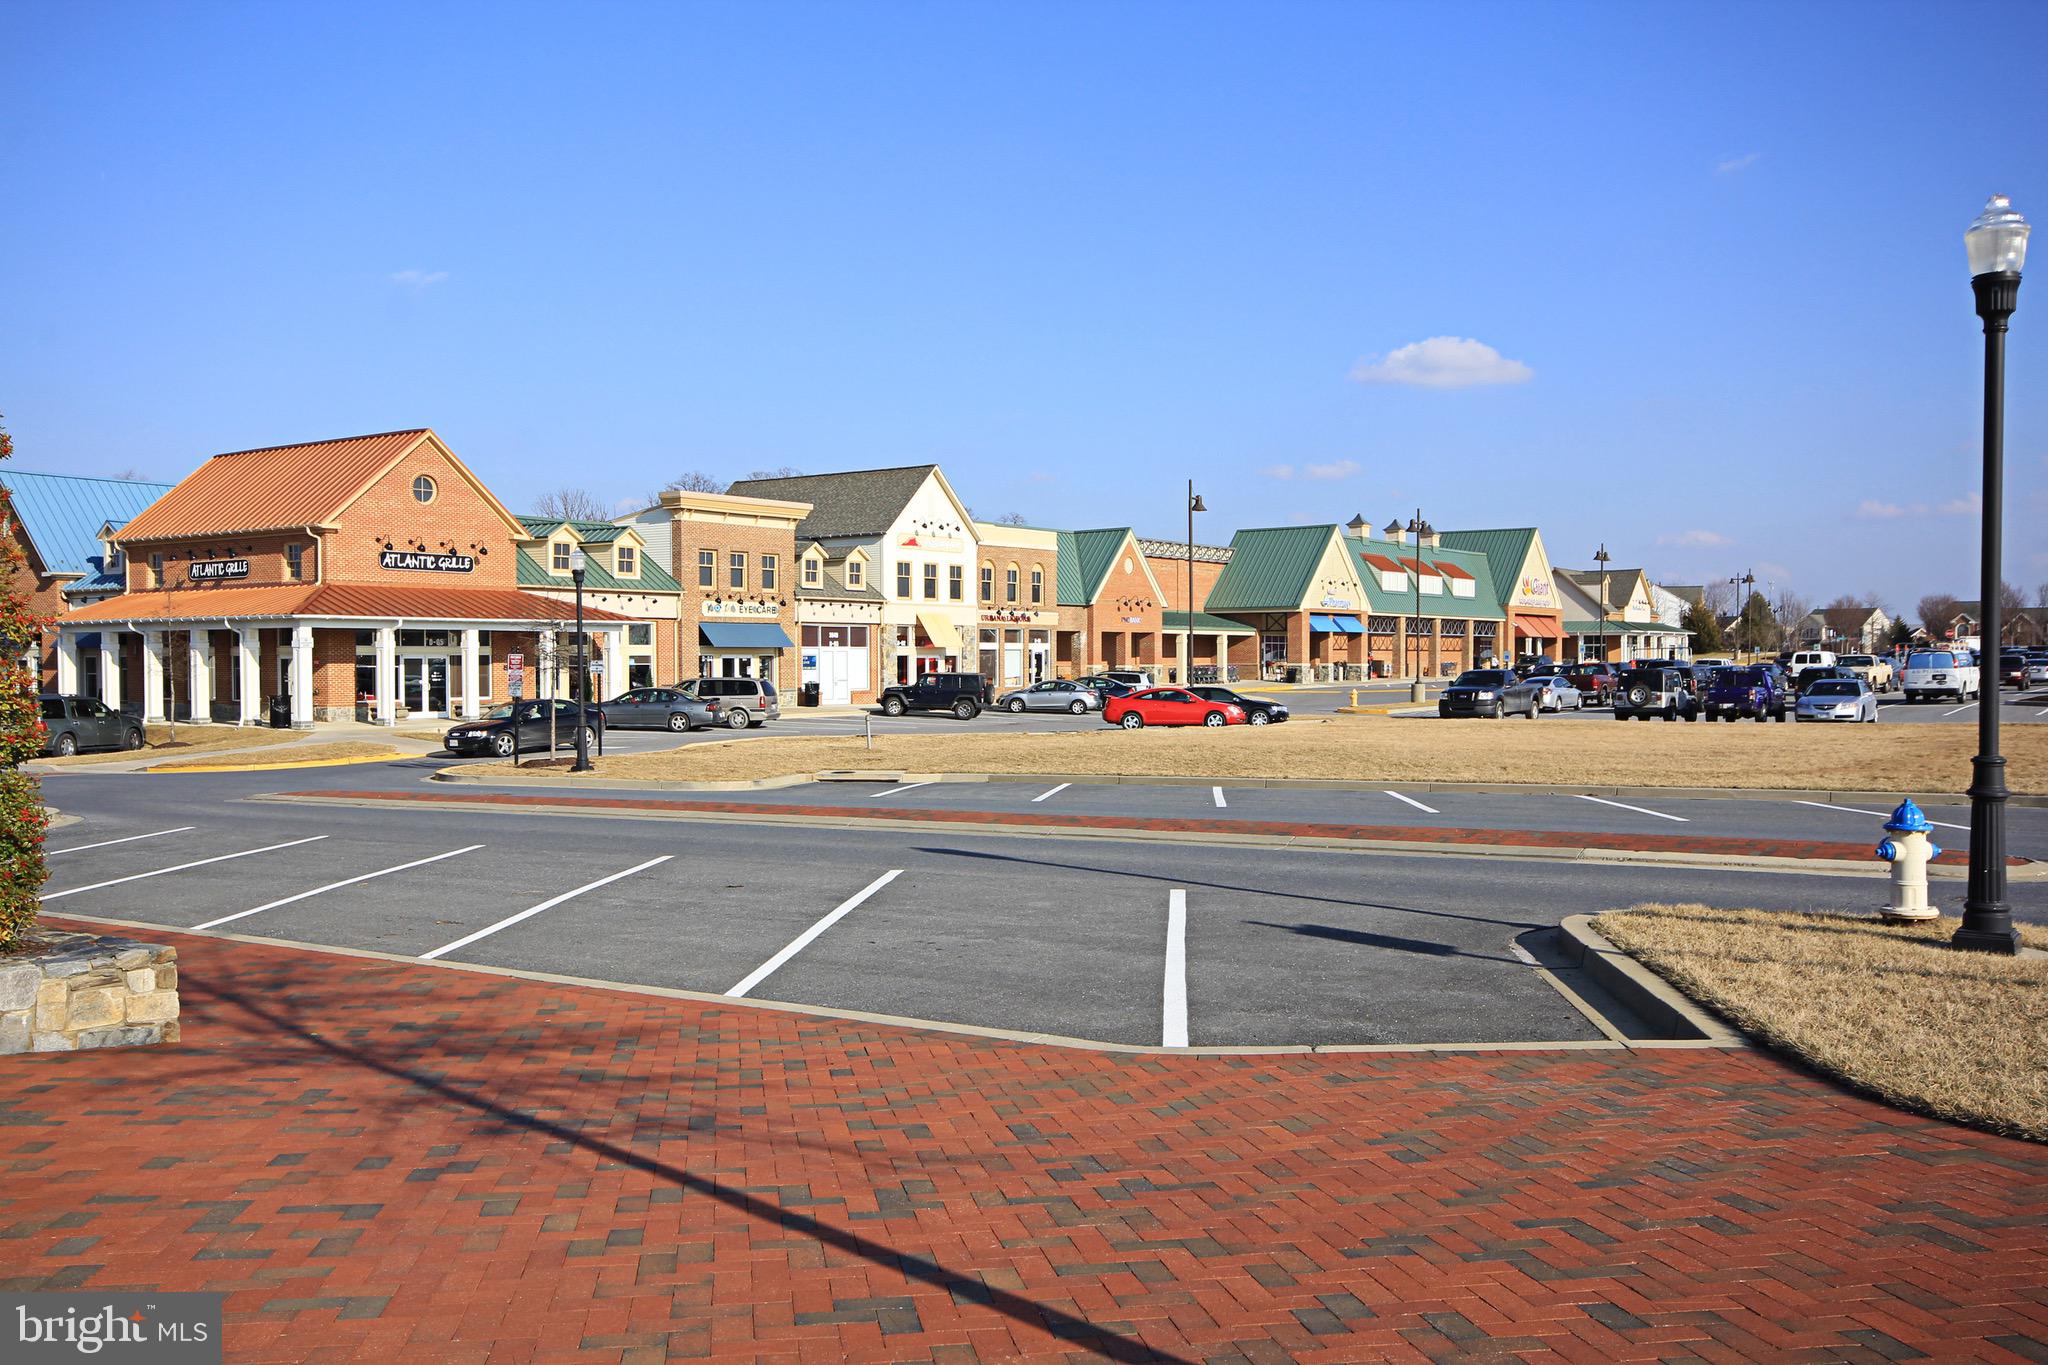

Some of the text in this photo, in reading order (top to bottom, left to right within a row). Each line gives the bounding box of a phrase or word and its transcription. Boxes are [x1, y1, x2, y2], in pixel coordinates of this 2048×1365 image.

[191, 561, 248, 577] ATLANTIC GRILLE
[382, 553, 471, 571] ATLANTIC GRILLE
[739, 605, 753, 614] EYE
